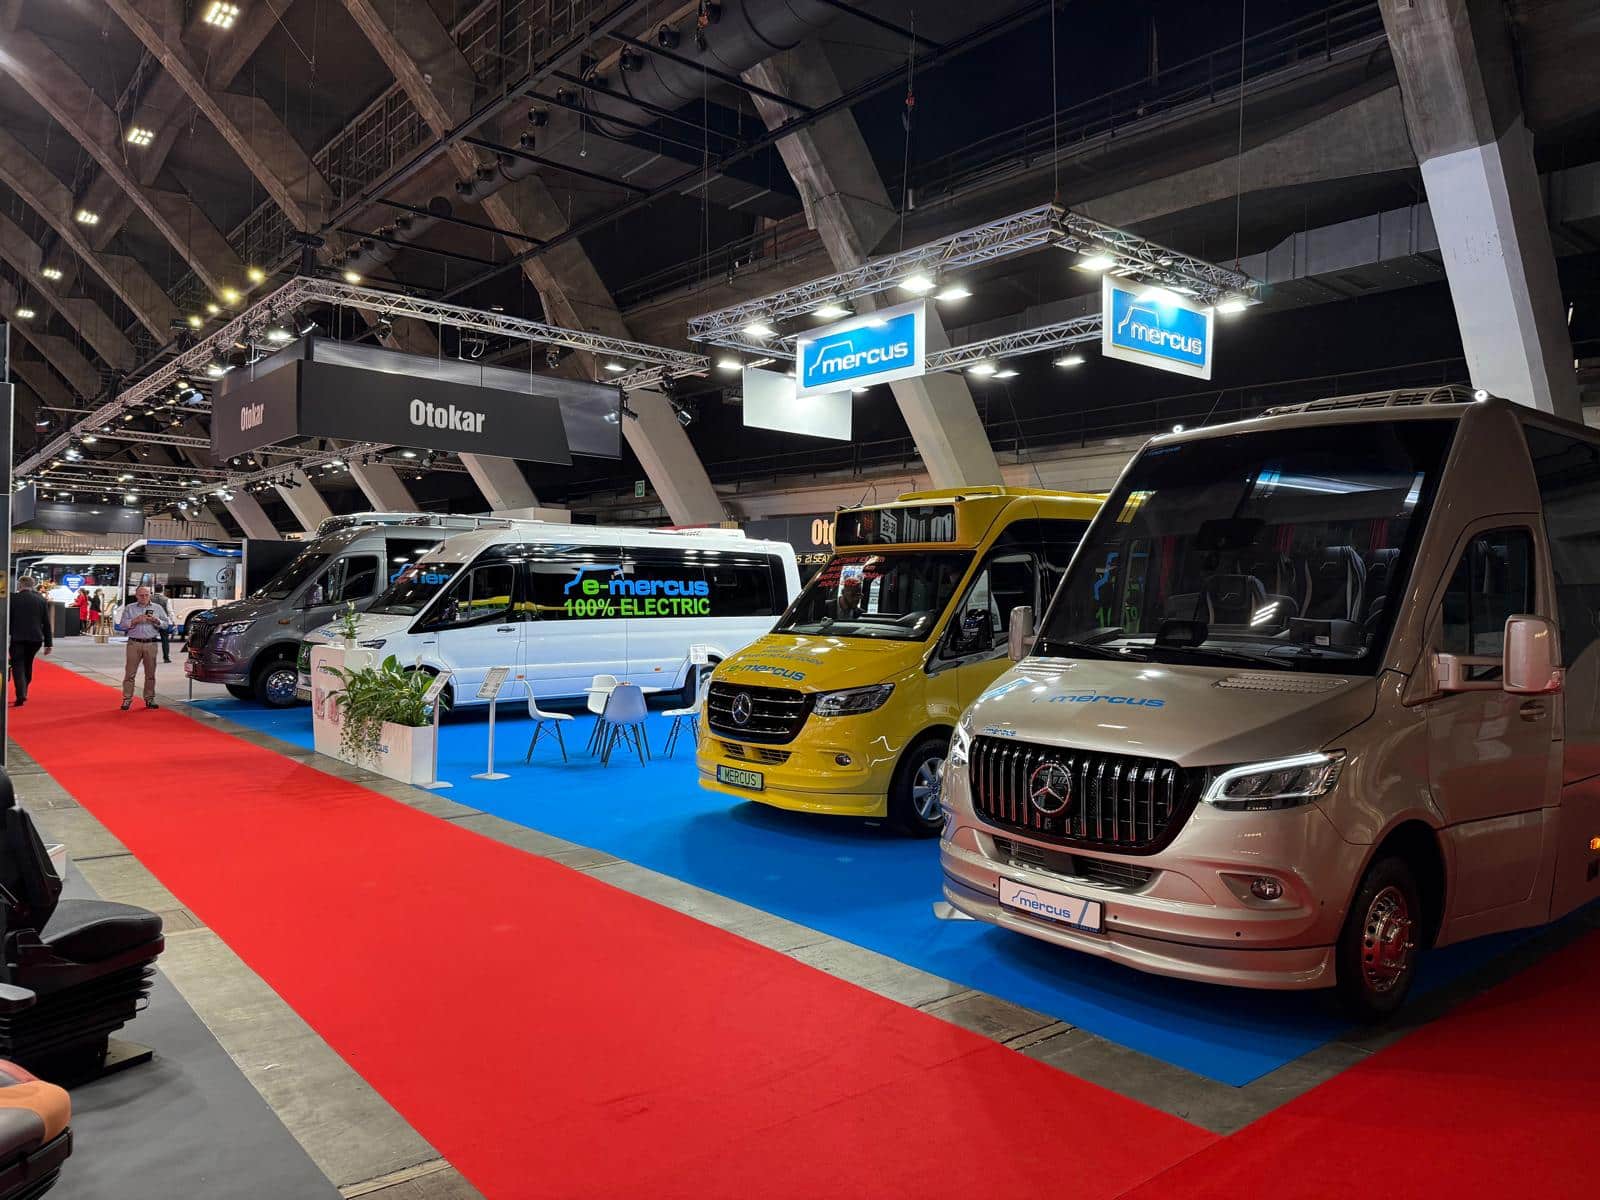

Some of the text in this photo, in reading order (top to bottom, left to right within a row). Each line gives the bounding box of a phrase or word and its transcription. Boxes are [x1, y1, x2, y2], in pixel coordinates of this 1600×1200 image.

[1130, 322, 1202, 355] mercus
[822, 342, 909, 374] mercus
[240, 402, 264, 431] Otokar
[410, 399, 486, 433] Otokar
[582, 579, 710, 596] e-mercus
[564, 598, 711, 616] 100% ELECTRIC
[1050, 694, 1167, 708] mercus
[724, 767, 757, 786] MERCUS
[1019, 896, 1071, 919] mercus
